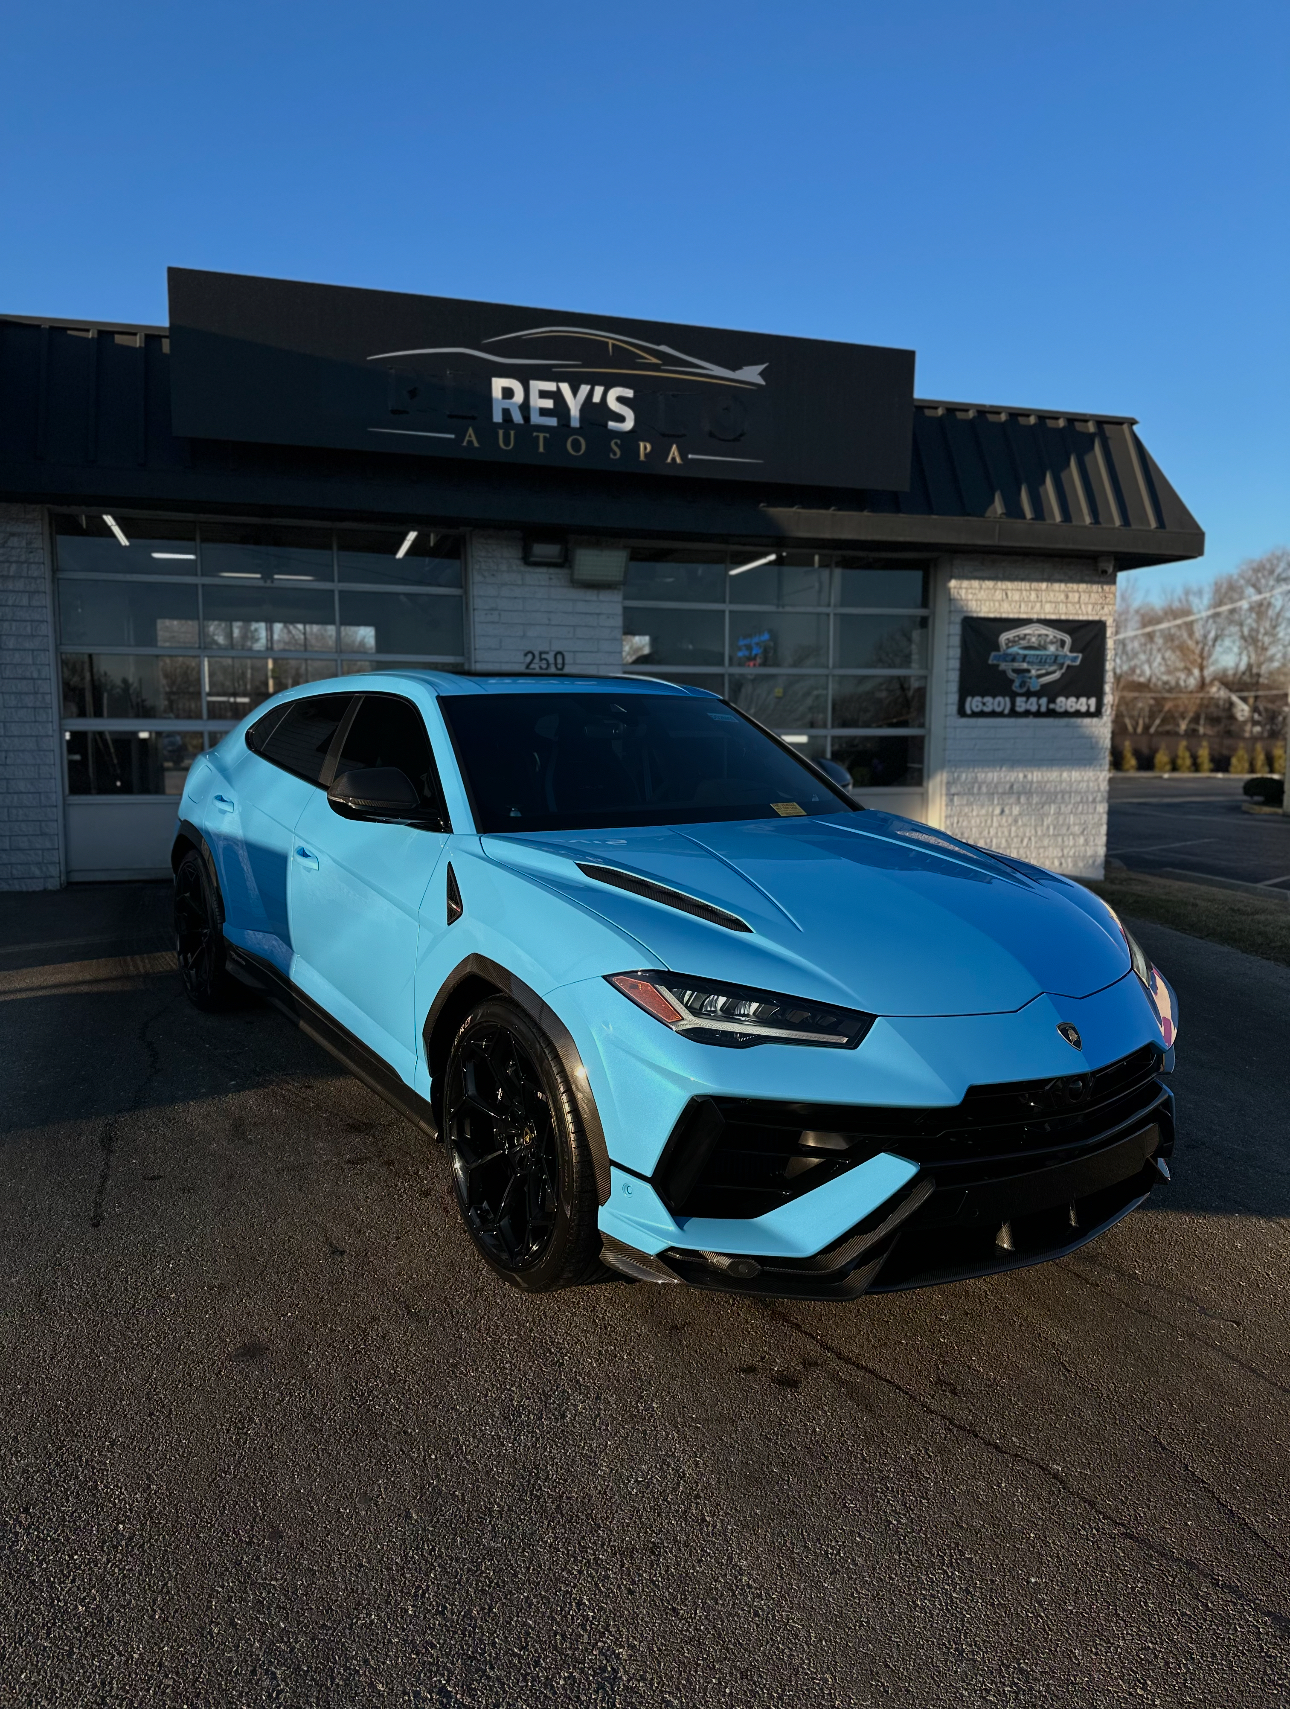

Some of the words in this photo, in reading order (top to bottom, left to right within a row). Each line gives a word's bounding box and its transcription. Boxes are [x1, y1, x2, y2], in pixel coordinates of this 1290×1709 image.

[491, 376, 635, 433] REY'S
[461, 426, 586, 456] AUTO
[609, 439, 684, 465] SPA
[523, 650, 566, 671] 250
[1025, 654, 1055, 663] AUTO
[965, 696, 1011, 715] (630)
[1015, 696, 1097, 713] 541-8641
